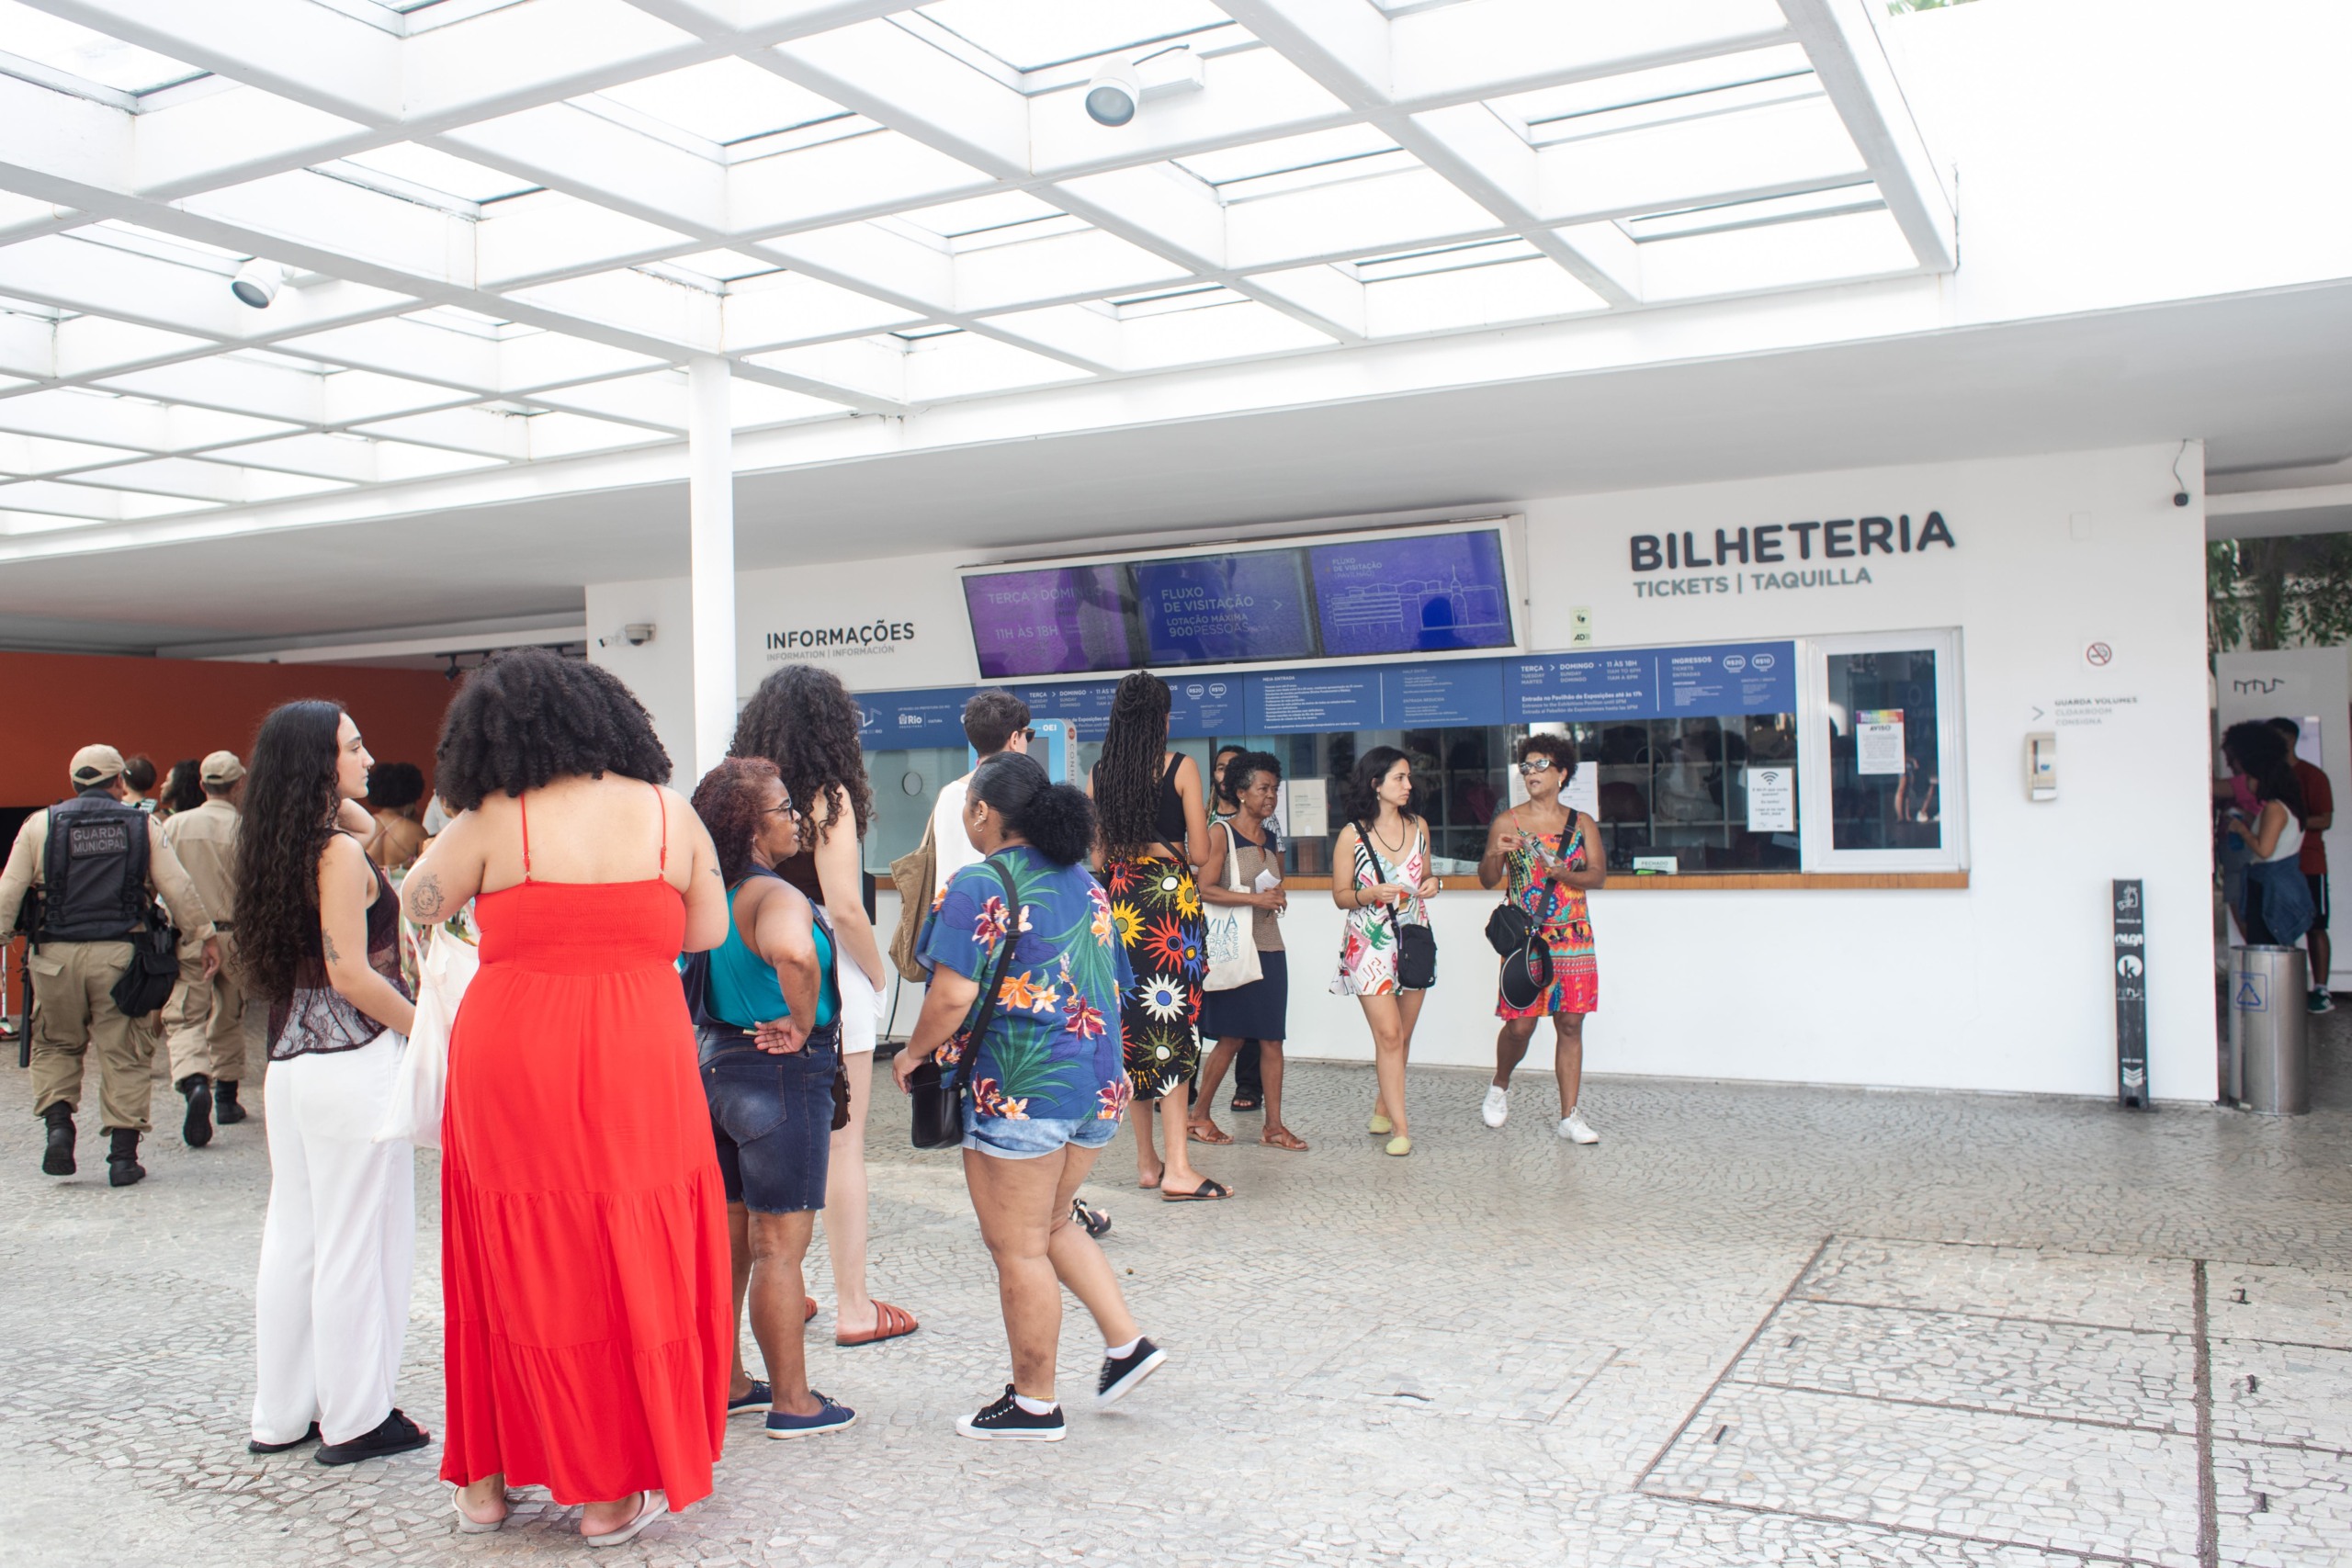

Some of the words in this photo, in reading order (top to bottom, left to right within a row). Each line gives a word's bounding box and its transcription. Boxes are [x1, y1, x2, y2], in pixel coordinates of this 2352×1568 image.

[1630, 510, 1955, 572] BILHETERIA
[1344, 561, 1383, 571] VISITAÇÃO
[1633, 576, 1728, 598] TICKETS
[1750, 567, 1872, 592] TAQUILLA
[988, 590, 1031, 605] TERÇA
[1161, 586, 1204, 600] FLUXO
[1163, 601, 1182, 614] DE
[1183, 593, 1254, 610] VISITAÇÃO
[1167, 614, 1209, 626] LOTAÇÃO
[1211, 612, 1249, 625] MÁXIMA
[766, 619, 915, 650] INFORMAÇÕES
[995, 628, 1014, 640] 11H
[1017, 625, 1035, 637] ÀS
[1036, 625, 1059, 637] 18H
[766, 649, 825, 662] INFORMATION
[831, 644, 896, 658] INFORMACIÓN
[1671, 656, 1713, 664] INGRESSOS
[1521, 664, 1544, 674] TERÇA
[1559, 661, 1595, 671] DOMINGO
[1584, 692, 1615, 701] Exposições
[2054, 697, 2092, 706] GUARDA
[2095, 695, 2138, 705] VOLUMES
[908, 715, 922, 725] Rio
[1042, 724, 1057, 732] OEI
[73, 827, 125, 841] GUARDA
[73, 838, 127, 853] MUNICIPAL
